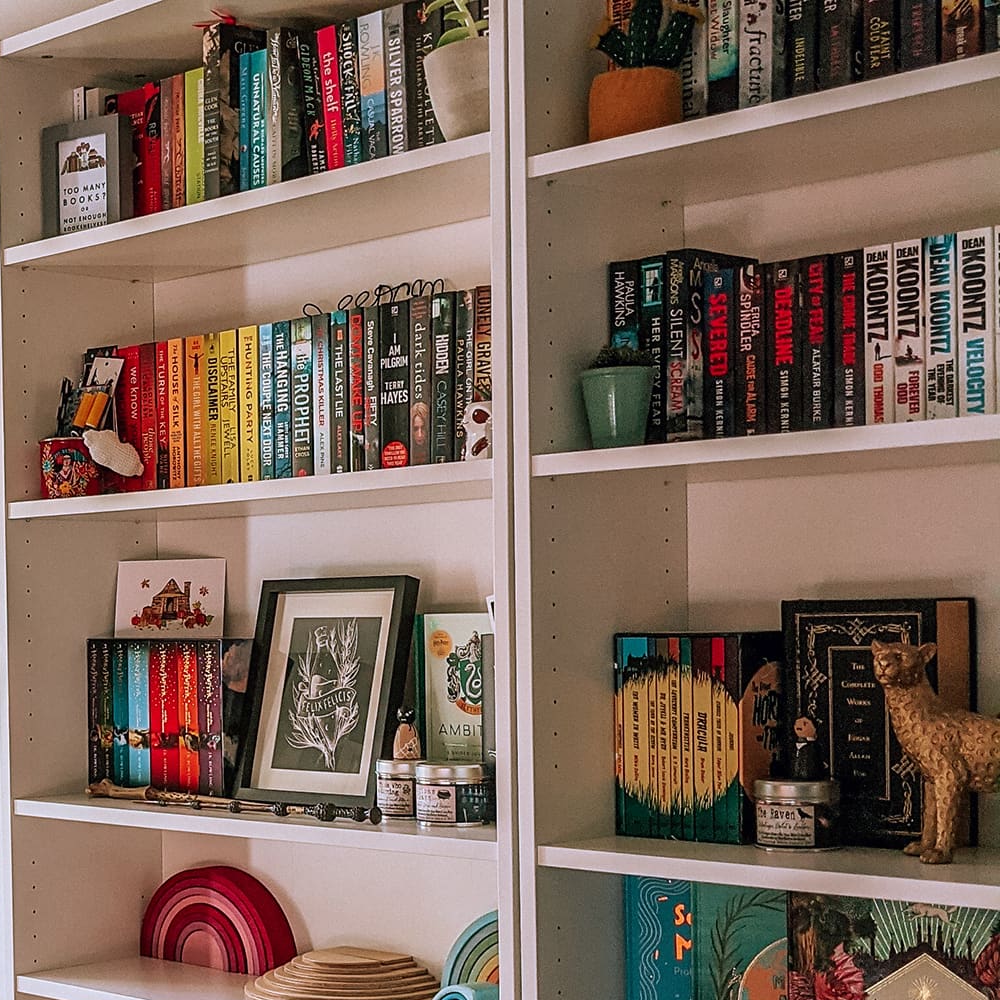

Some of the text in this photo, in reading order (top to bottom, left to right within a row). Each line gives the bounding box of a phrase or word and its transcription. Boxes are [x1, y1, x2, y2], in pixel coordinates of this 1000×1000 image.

[300, 43, 313, 82] GIDEON
[321, 51, 339, 113] the shelf
[359, 23, 370, 89] ROWLING
[388, 38, 404, 156] SILVER SPARROW
[252, 73, 260, 186] UNNATURAL CAUSES
[63, 181, 106, 196] TOO MANY
[63, 192, 106, 207] BOOKS?
[63, 213, 106, 224] NOT ENOUGH
[962, 236, 985, 250] DEAN
[808, 262, 825, 294] CITY
[866, 250, 888, 263] DEAN
[896, 246, 919, 258] DEAN
[476, 288, 491, 337] LONELY
[614, 271, 626, 327] HAWKINS
[625, 280, 635, 317] PAULA
[866, 262, 889, 344] KOONTZ
[896, 258, 920, 340] KOONTZ
[929, 243, 951, 356] DEAN KOONTZ
[962, 250, 986, 334] KOONTZ
[708, 293, 728, 377] SEVERED
[740, 294, 752, 352] SPINDLER
[750, 306, 760, 337] ERICA
[774, 286, 794, 399] DEADLINE SIMON
[275, 332, 288, 413] THE HANGING
[366, 319, 375, 392] Steve Cavanagh
[380, 356, 408, 368] PILGRIM
[388, 345, 401, 356] AM
[414, 322, 427, 400] dark tides
[435, 334, 449, 375] HIDDEN
[651, 317, 661, 426] HER FEAR
[669, 308, 684, 412] SILENT SCREAM
[966, 337, 985, 415] VELOCITY
[130, 366, 138, 420] we know
[158, 365, 166, 396] TURN
[171, 356, 180, 428] HOUSE SILK
[207, 357, 219, 422] DISCLAIMER
[220, 356, 229, 409] UPSTAIRS
[228, 347, 237, 414] THE FAMILY
[244, 343, 254, 444] HUNTING PARTY
[262, 350, 272, 467] THE COUPLE NEXT DOOR
[294, 353, 310, 445] the PROPHET
[317, 340, 325, 427] CHRISTMAS KILLER
[335, 343, 344, 419] THE LAST LIE
[351, 362, 363, 433] WAKE UP
[380, 391, 408, 405] HAYES
[385, 381, 404, 390] TERRY
[436, 380, 447, 423] CASEY
[456, 339, 465, 439] PAULA HAWKINS
[812, 349, 822, 423] ALAFAIR BURKE
[873, 362, 884, 424] ODD THOMAS
[896, 382, 908, 405] ODD
[908, 370, 920, 415] FOREVER
[222, 419, 230, 459] JEWELL
[370, 395, 378, 427] FIFTY
[840, 680, 876, 689] COMPLETE
[851, 662, 866, 671] THE
[301, 691, 352, 712] FELIX FELICIS
[438, 723, 482, 736] AMBIT
[770, 807, 796, 821] Raven
